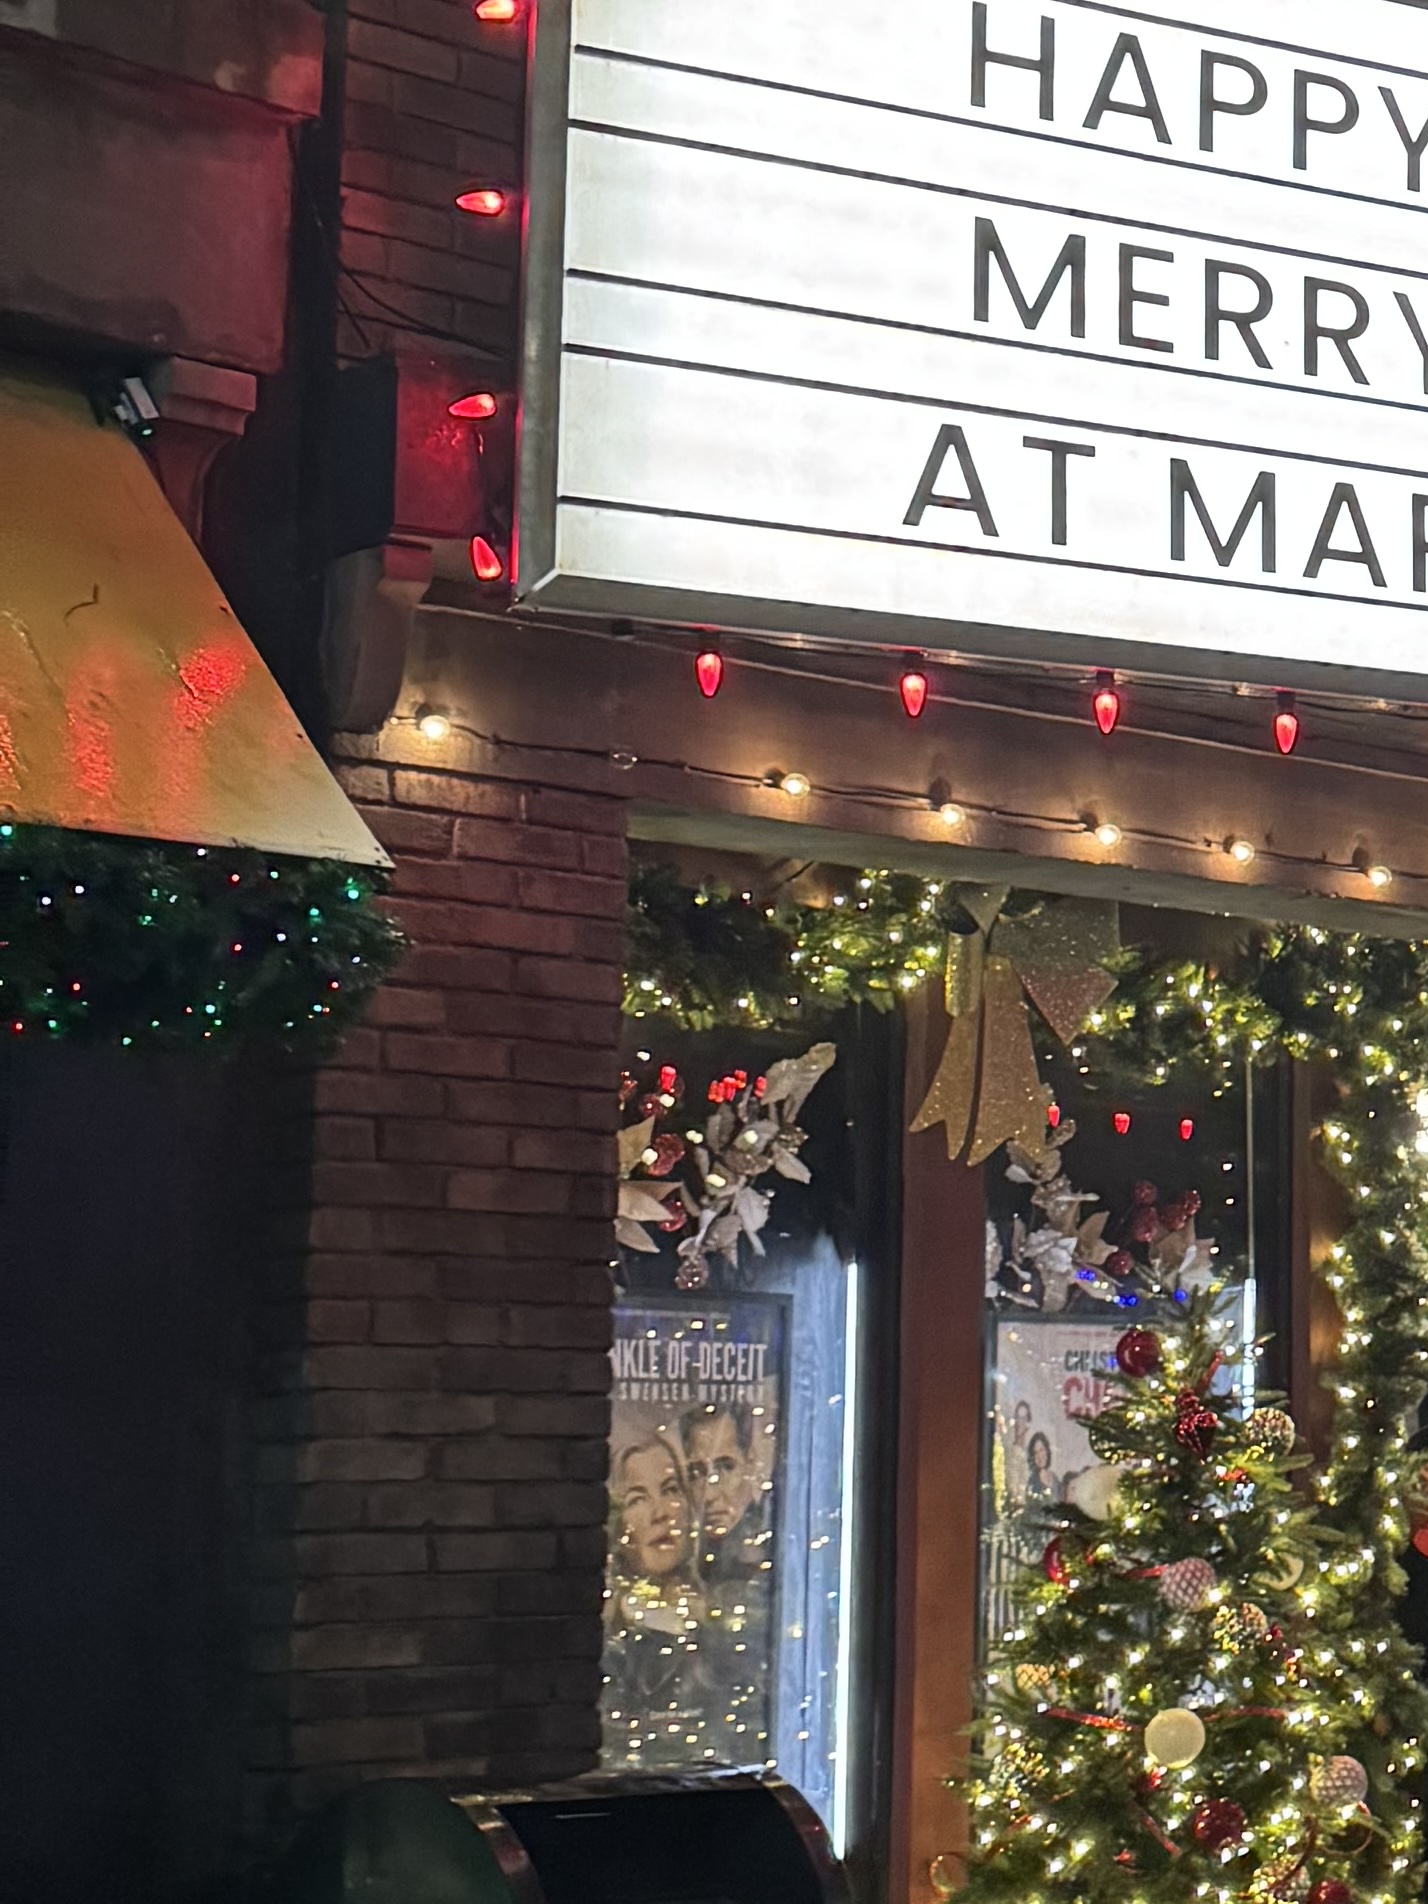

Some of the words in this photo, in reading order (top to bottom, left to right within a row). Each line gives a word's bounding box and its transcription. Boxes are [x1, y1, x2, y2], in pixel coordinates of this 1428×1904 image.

[902, 423, 1096, 546] AT
[610, 1339, 661, 1378] NKLE
[667, 1341, 691, 1380] OF
[700, 1343, 767, 1381] DECEIT
